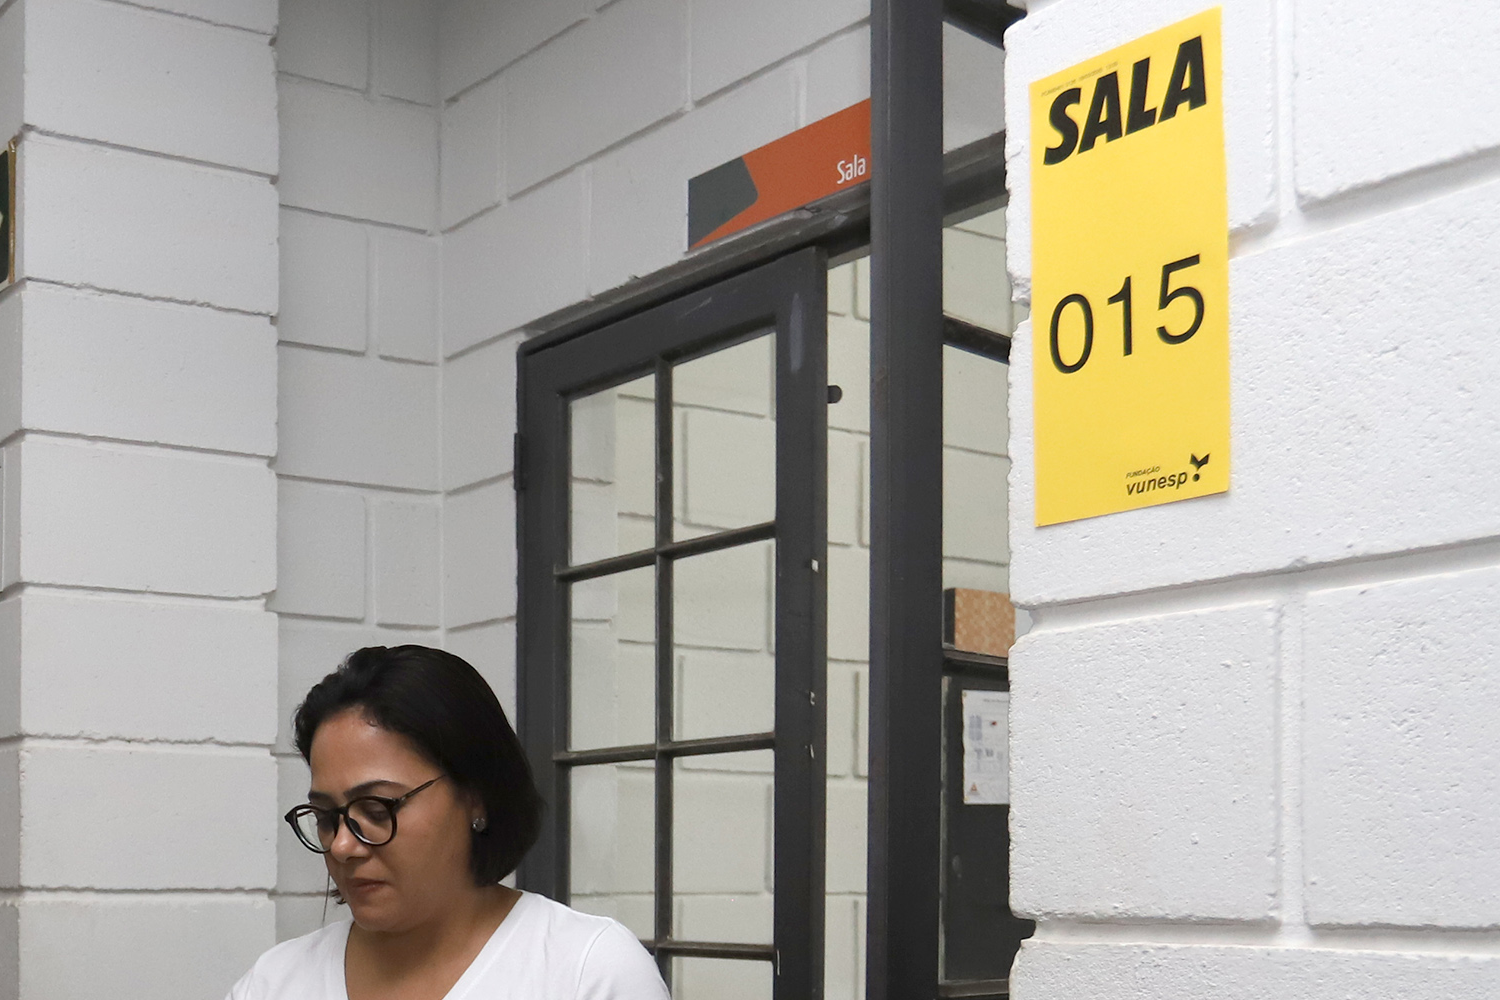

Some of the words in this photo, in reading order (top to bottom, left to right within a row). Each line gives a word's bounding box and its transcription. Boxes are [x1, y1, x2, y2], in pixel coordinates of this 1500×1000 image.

[1043, 35, 1207, 165] SALA
[836, 154, 866, 184] Sala
[1049, 254, 1205, 374] 015
[1126, 466, 1160, 479] FUNDAÇÃO
[1126, 472, 1188, 496] vunesp
